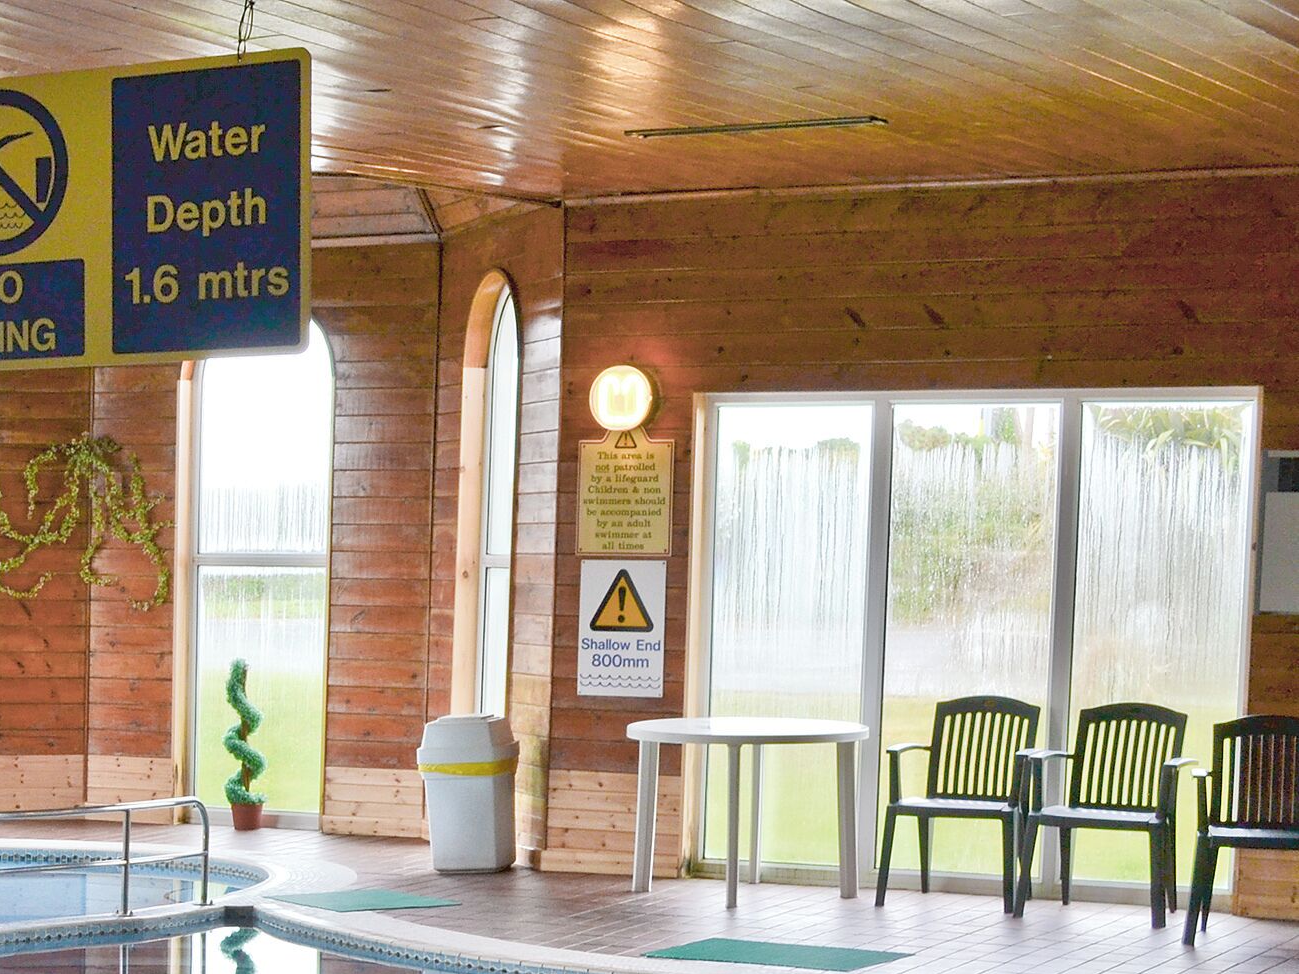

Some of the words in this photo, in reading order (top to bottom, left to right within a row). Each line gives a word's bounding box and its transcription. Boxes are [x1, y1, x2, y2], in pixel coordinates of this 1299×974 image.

[148, 122, 266, 163] Water
[147, 188, 266, 237] Depth
[125, 264, 179, 304] 1.6
[198, 261, 290, 300] mtrs
[597, 452, 618, 460] This
[646, 452, 655, 460] is
[614, 463, 655, 473] patrolled
[591, 475, 602, 483] by
[615, 474, 659, 484] lifeguard
[588, 486, 629, 494] Children
[632, 486, 640, 494] &
[583, 497, 631, 505] swimmers
[635, 497, 666, 505] should
[586, 508, 597, 516] be
[600, 508, 662, 518] accompanied
[596, 519, 608, 528] by
[627, 519, 651, 528] adult
[595, 531, 639, 539] swimmer
[642, 531, 652, 539] at
[602, 542, 614, 550] all
[618, 542, 644, 550] times
[581, 638, 631, 651] Shallow
[636, 639, 661, 651] End
[591, 654, 649, 668] 800mm
